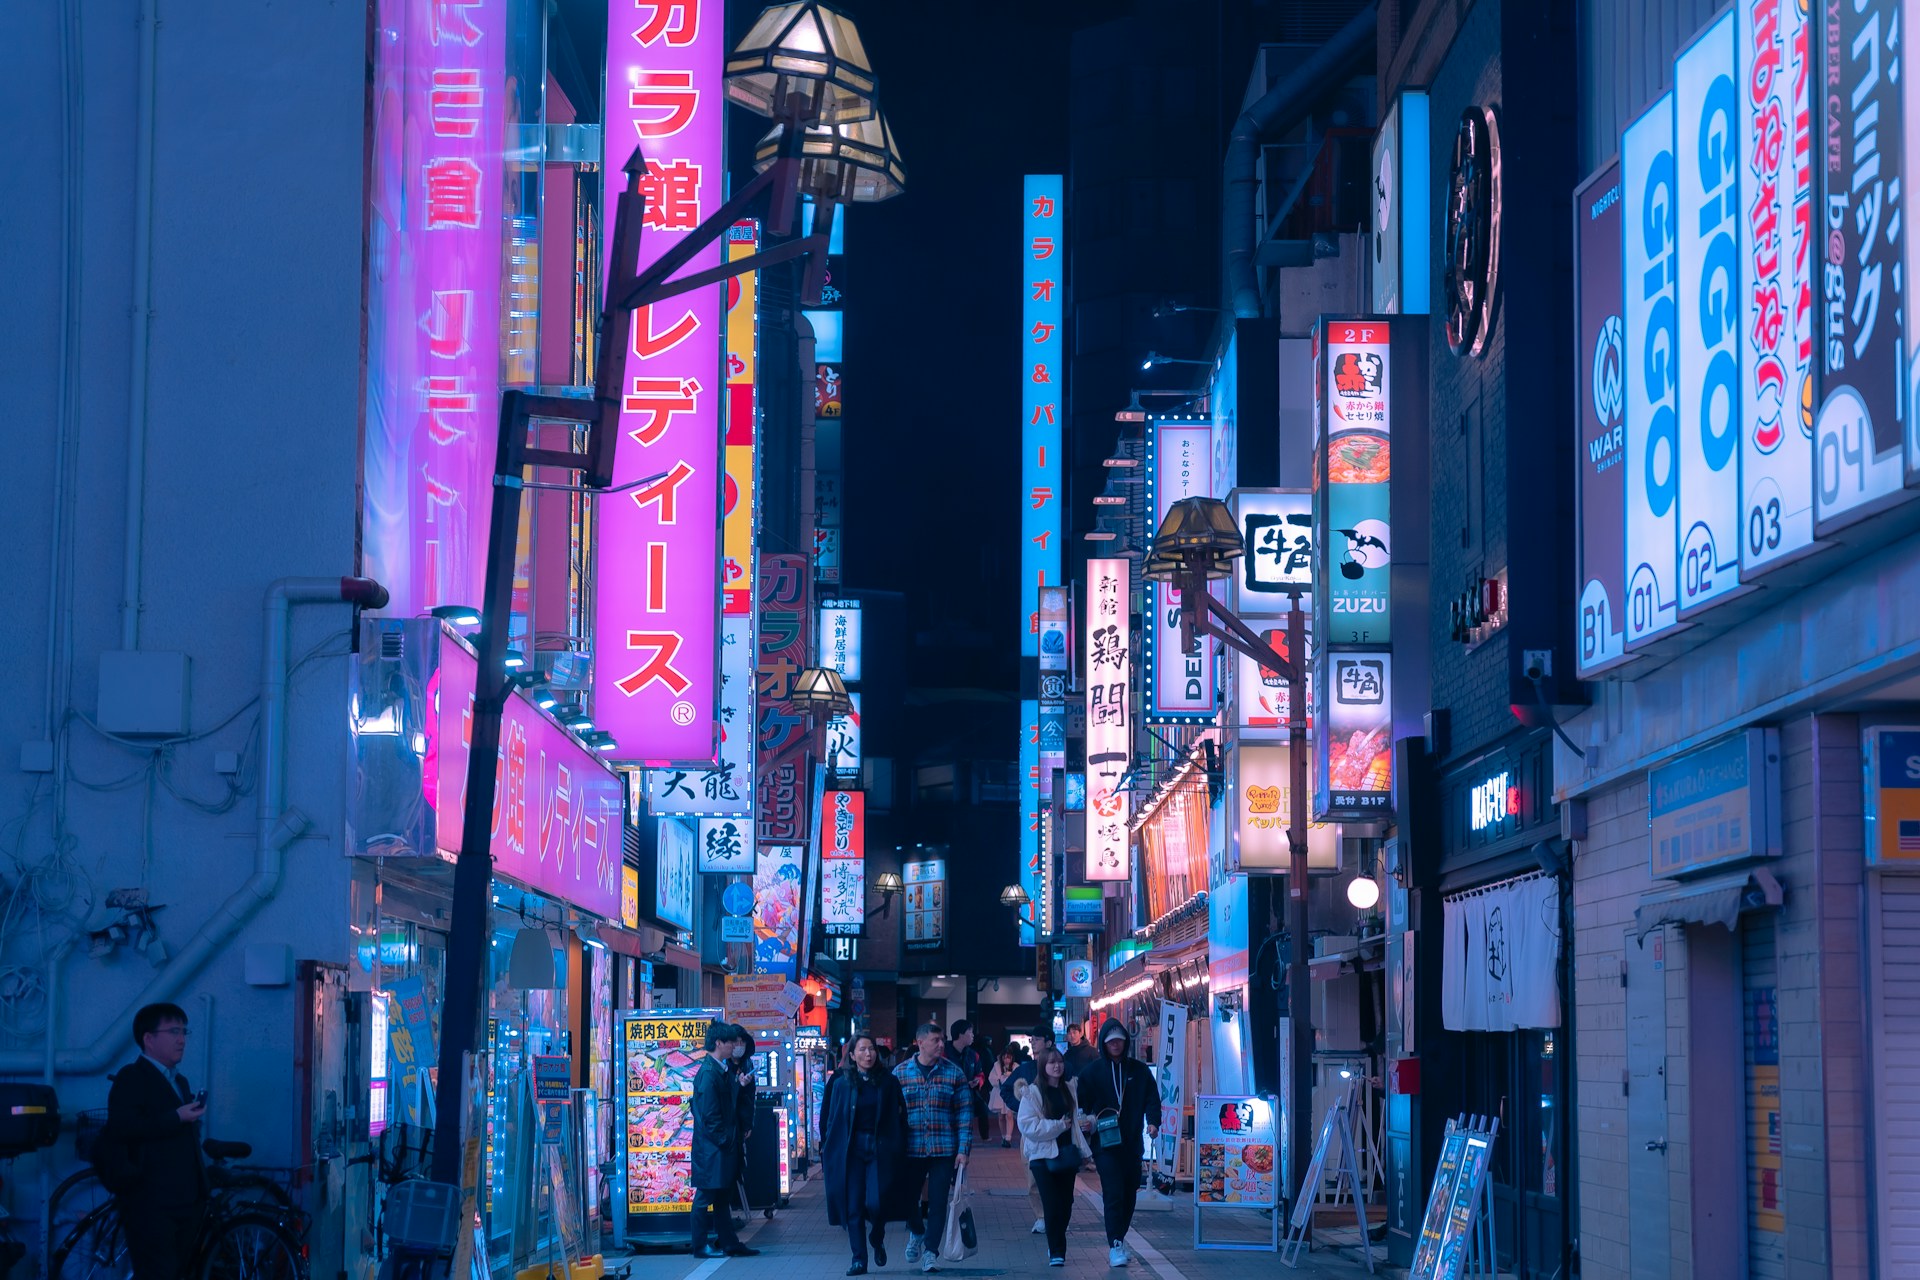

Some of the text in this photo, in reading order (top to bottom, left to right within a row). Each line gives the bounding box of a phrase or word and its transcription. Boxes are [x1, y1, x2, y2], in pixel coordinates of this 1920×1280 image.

[1344, 329, 1374, 343] 2F
[1345, 401, 1385, 411] 赤から鍋
[1345, 411, 1385, 422] セセリ焼
[1820, 416, 1865, 506] 04
[1750, 497, 1782, 557] 03
[1686, 542, 1713, 597] 02
[1333, 597, 1387, 613] ZUZU
[1633, 583, 1652, 633] 01
[1351, 630, 1370, 643] 3F
[1583, 600, 1605, 662] B1
[758, 558, 802, 750] カラオケ
[1343, 668, 1379, 694] 牛角
[1334, 795, 1386, 806] 受付 B1F
[1067, 902, 1102, 912] FamilyMart
[825, 924, 861, 935] 地下2階
[630, 1021, 708, 1040] 焼肉食べ放題
